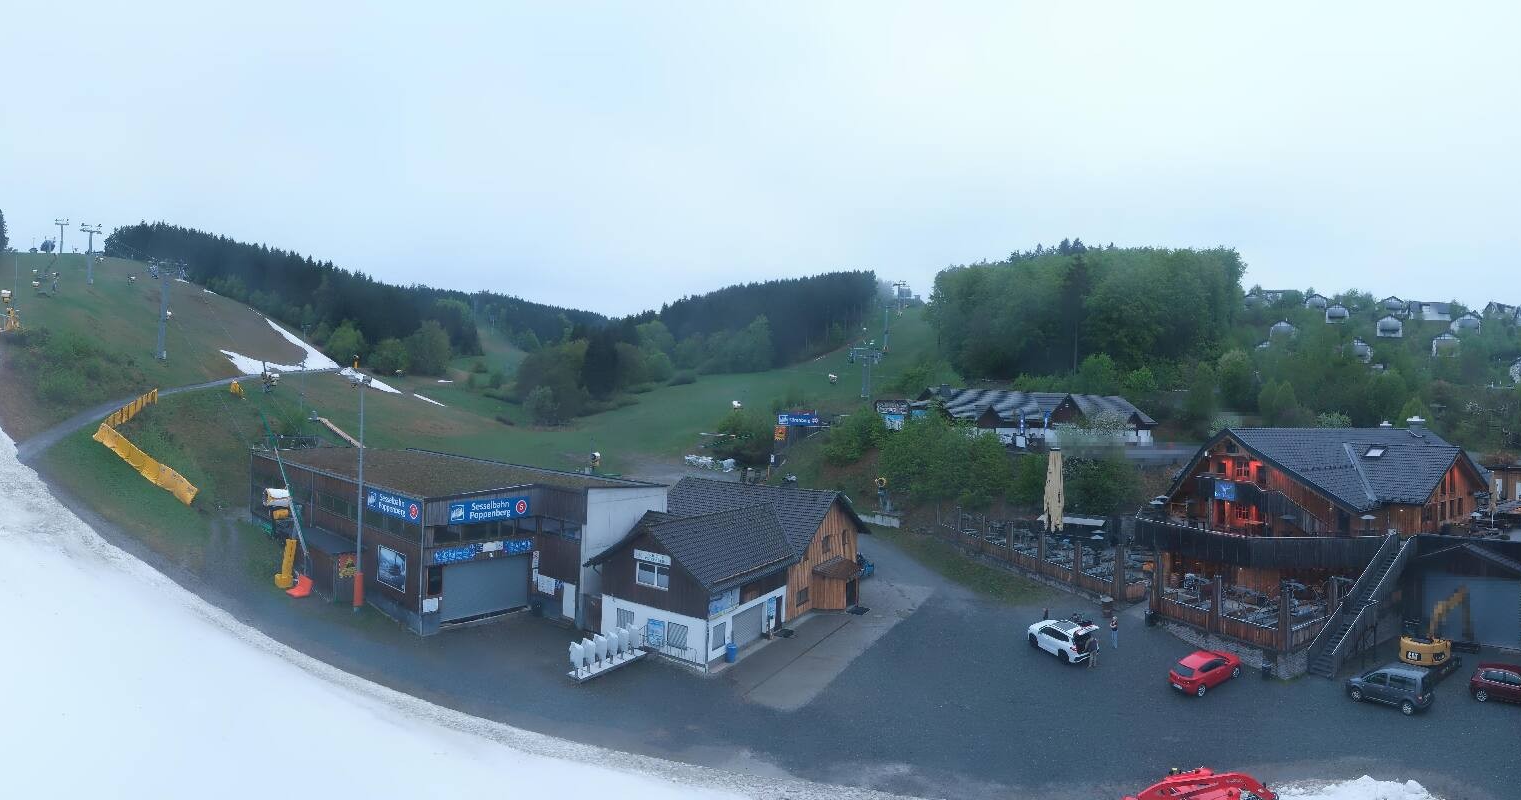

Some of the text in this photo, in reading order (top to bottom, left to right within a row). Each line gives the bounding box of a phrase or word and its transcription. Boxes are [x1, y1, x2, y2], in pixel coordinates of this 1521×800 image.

[379, 494, 405, 507] Sesselbahn
[471, 500, 510, 511] Sesselbahn
[378, 502, 406, 518] Poppenberg
[469, 509, 511, 520] Poppenberg
